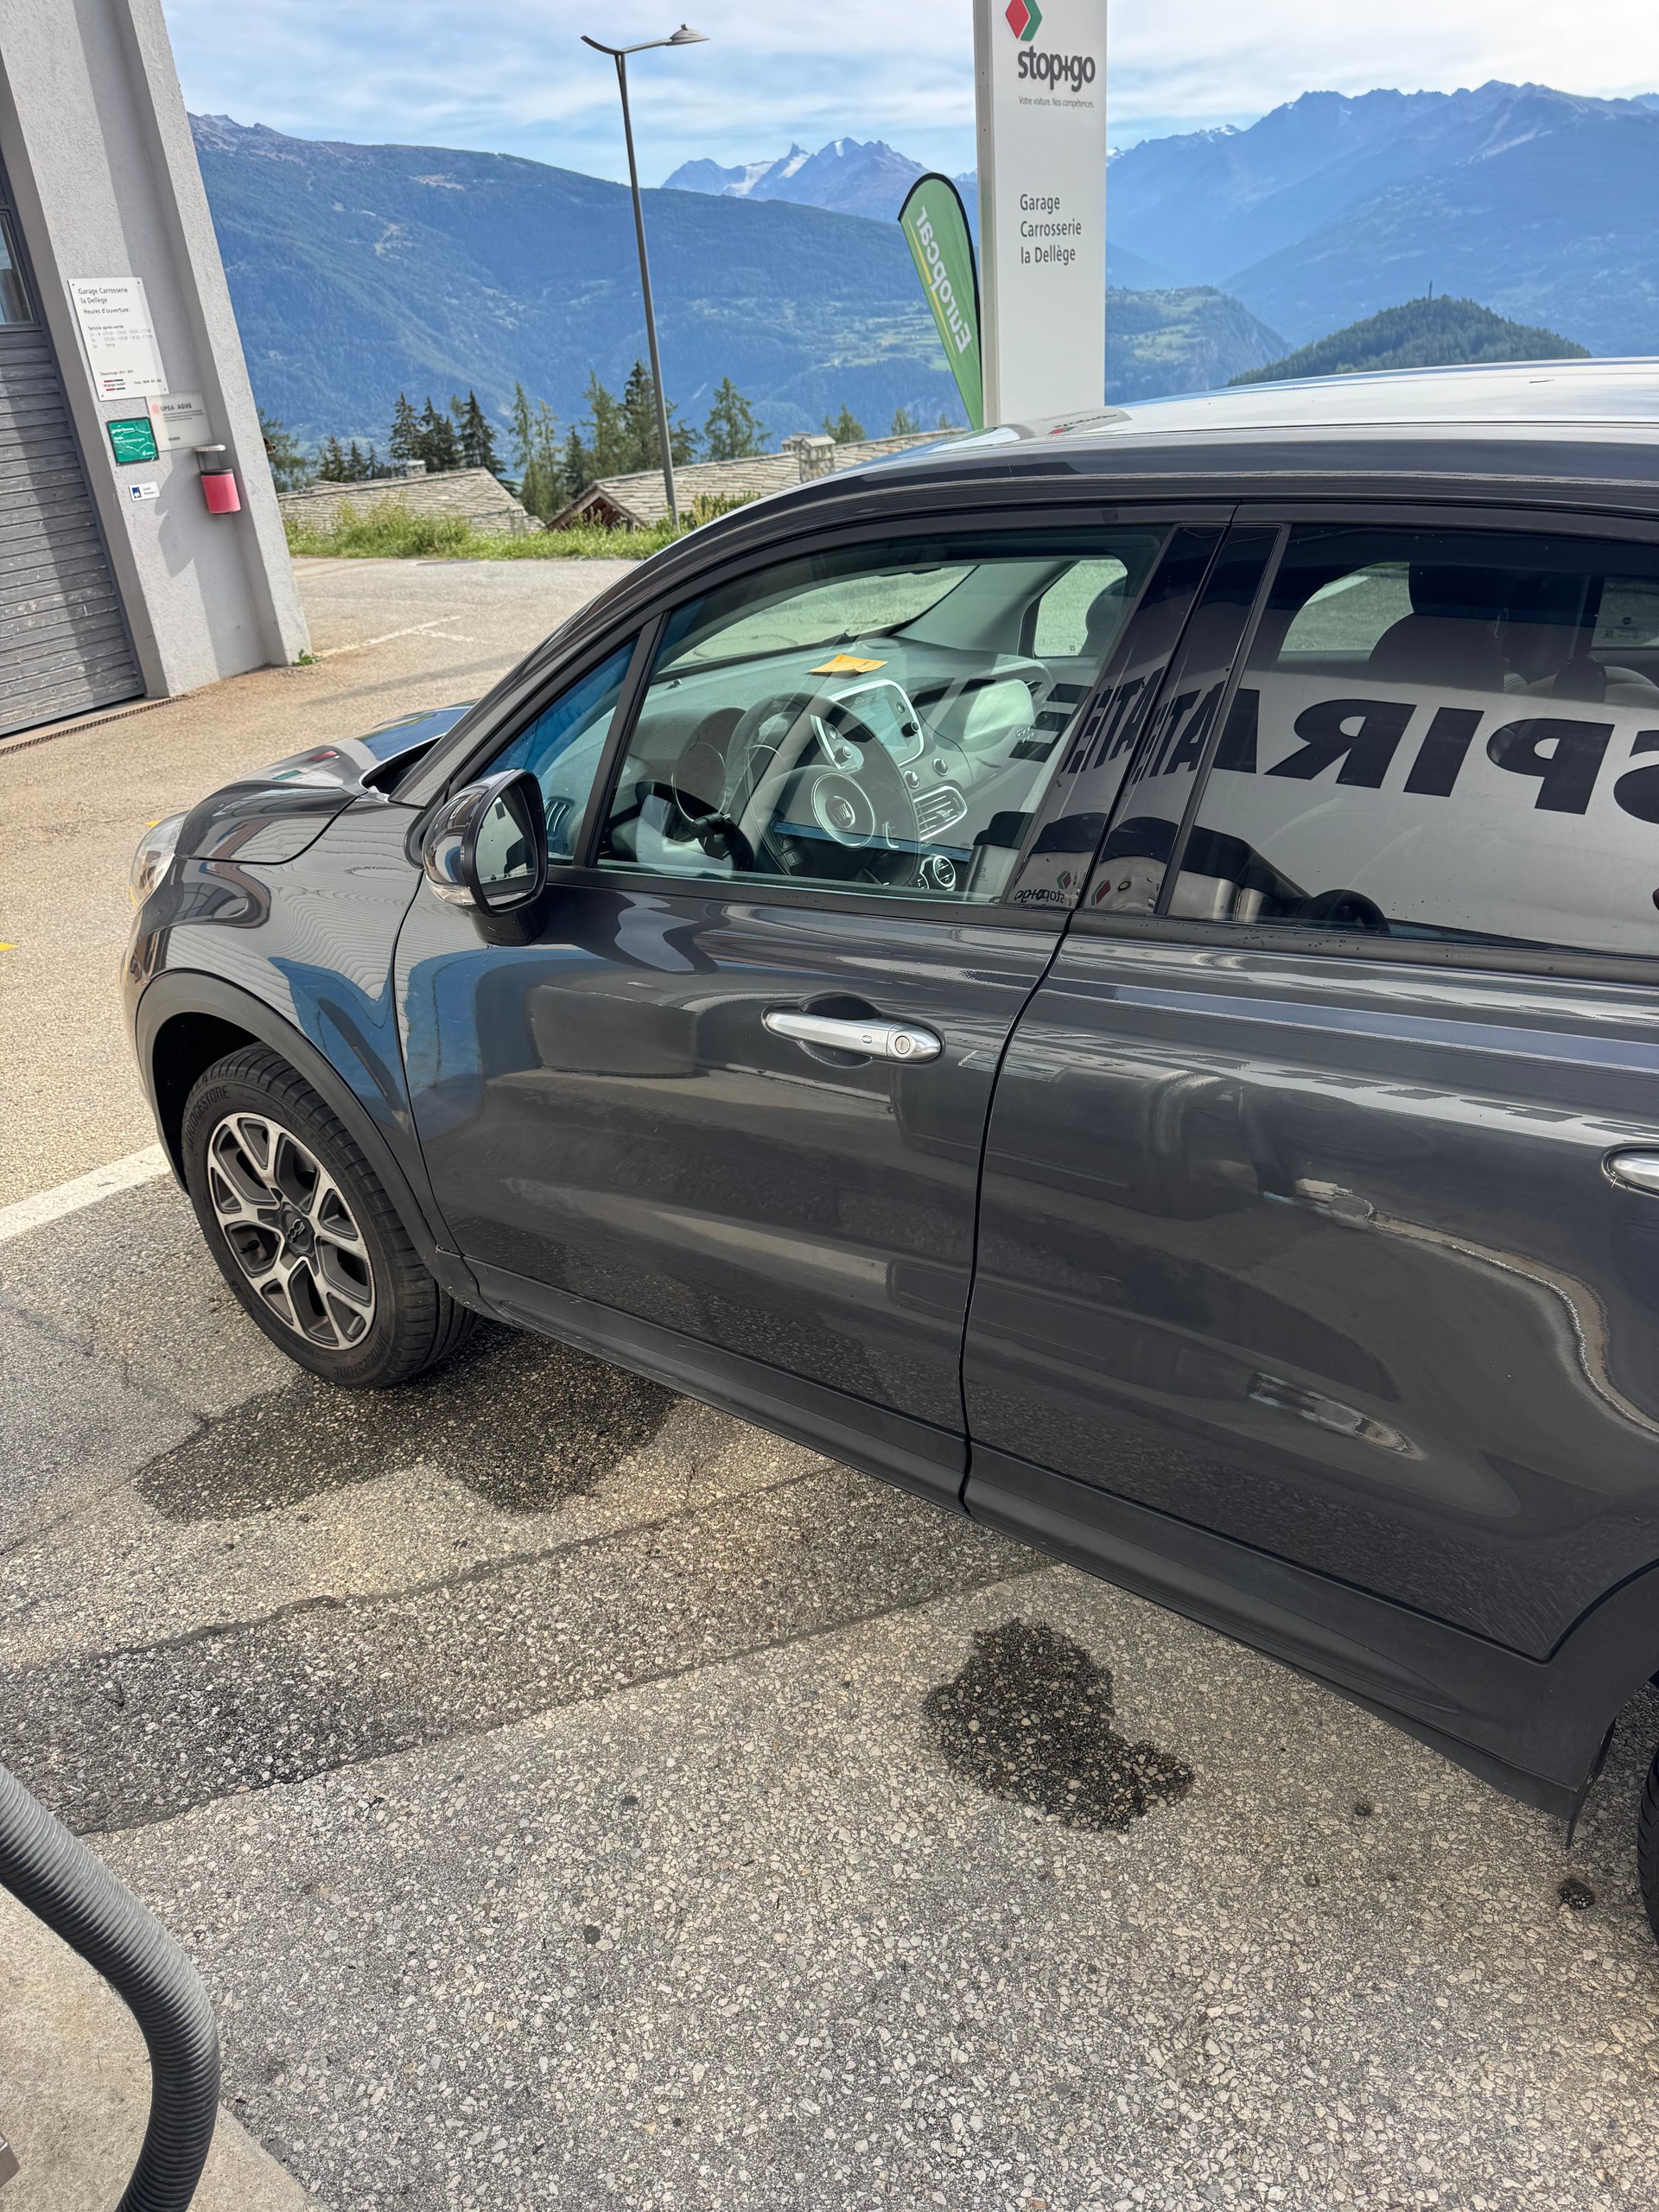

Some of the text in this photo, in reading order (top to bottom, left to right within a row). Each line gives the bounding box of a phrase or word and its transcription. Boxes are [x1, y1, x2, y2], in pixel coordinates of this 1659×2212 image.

[1017, 44, 1096, 92] stop+go
[1018, 96, 1033, 105] Votre
[1052, 98, 1062, 106] Nos
[1020, 193, 1061, 215] Garage
[1020, 218, 1082, 238] Carrosserie
[1020, 245, 1076, 266] la Dellège
[78, 288, 99, 296] Garage
